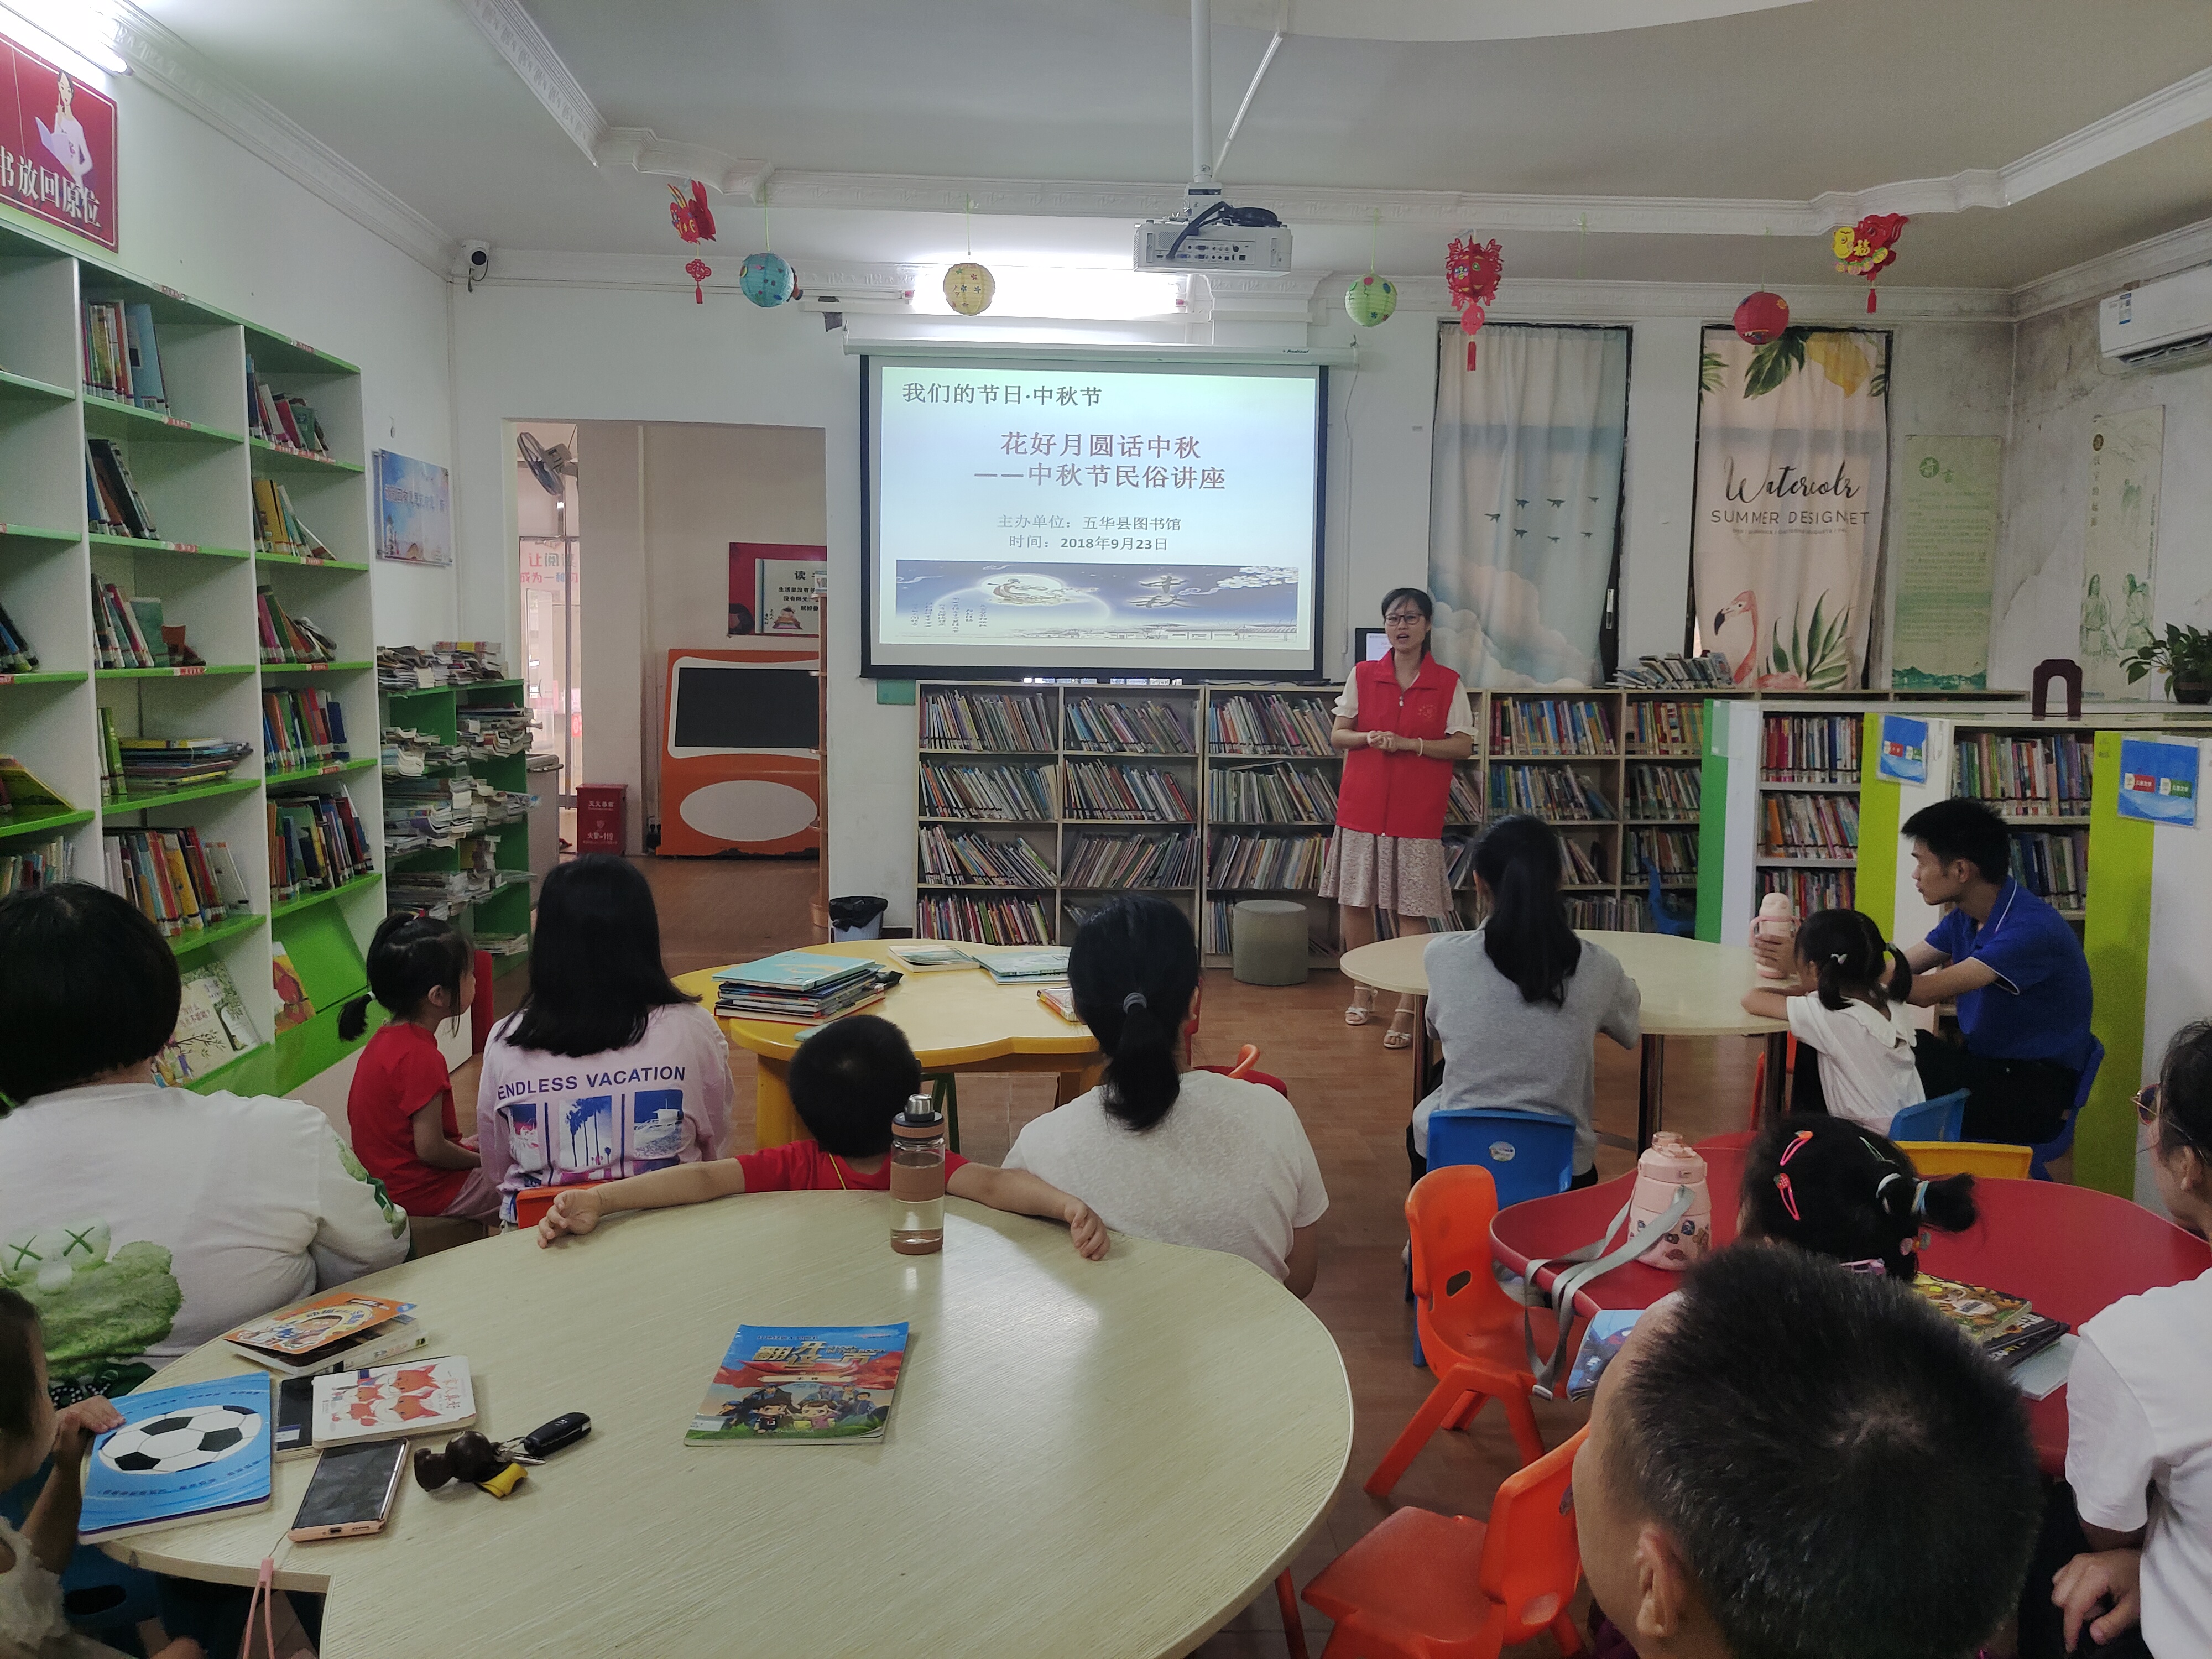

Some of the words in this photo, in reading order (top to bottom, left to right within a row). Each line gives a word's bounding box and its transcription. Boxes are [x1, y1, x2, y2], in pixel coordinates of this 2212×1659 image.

[0, 145, 101, 228] 书放回原位
[1854, 239, 1870, 256] 福
[902, 382, 1102, 407] 我们的节日·中秋节
[1000, 431, 1202, 460] 花好月圆话中秋
[1711, 510, 1780, 525] SUMMER
[498, 1075, 578, 1100] ENDLESS
[586, 1066, 686, 1088] VACATION
[442, 1370, 461, 1409] 一家人真好
